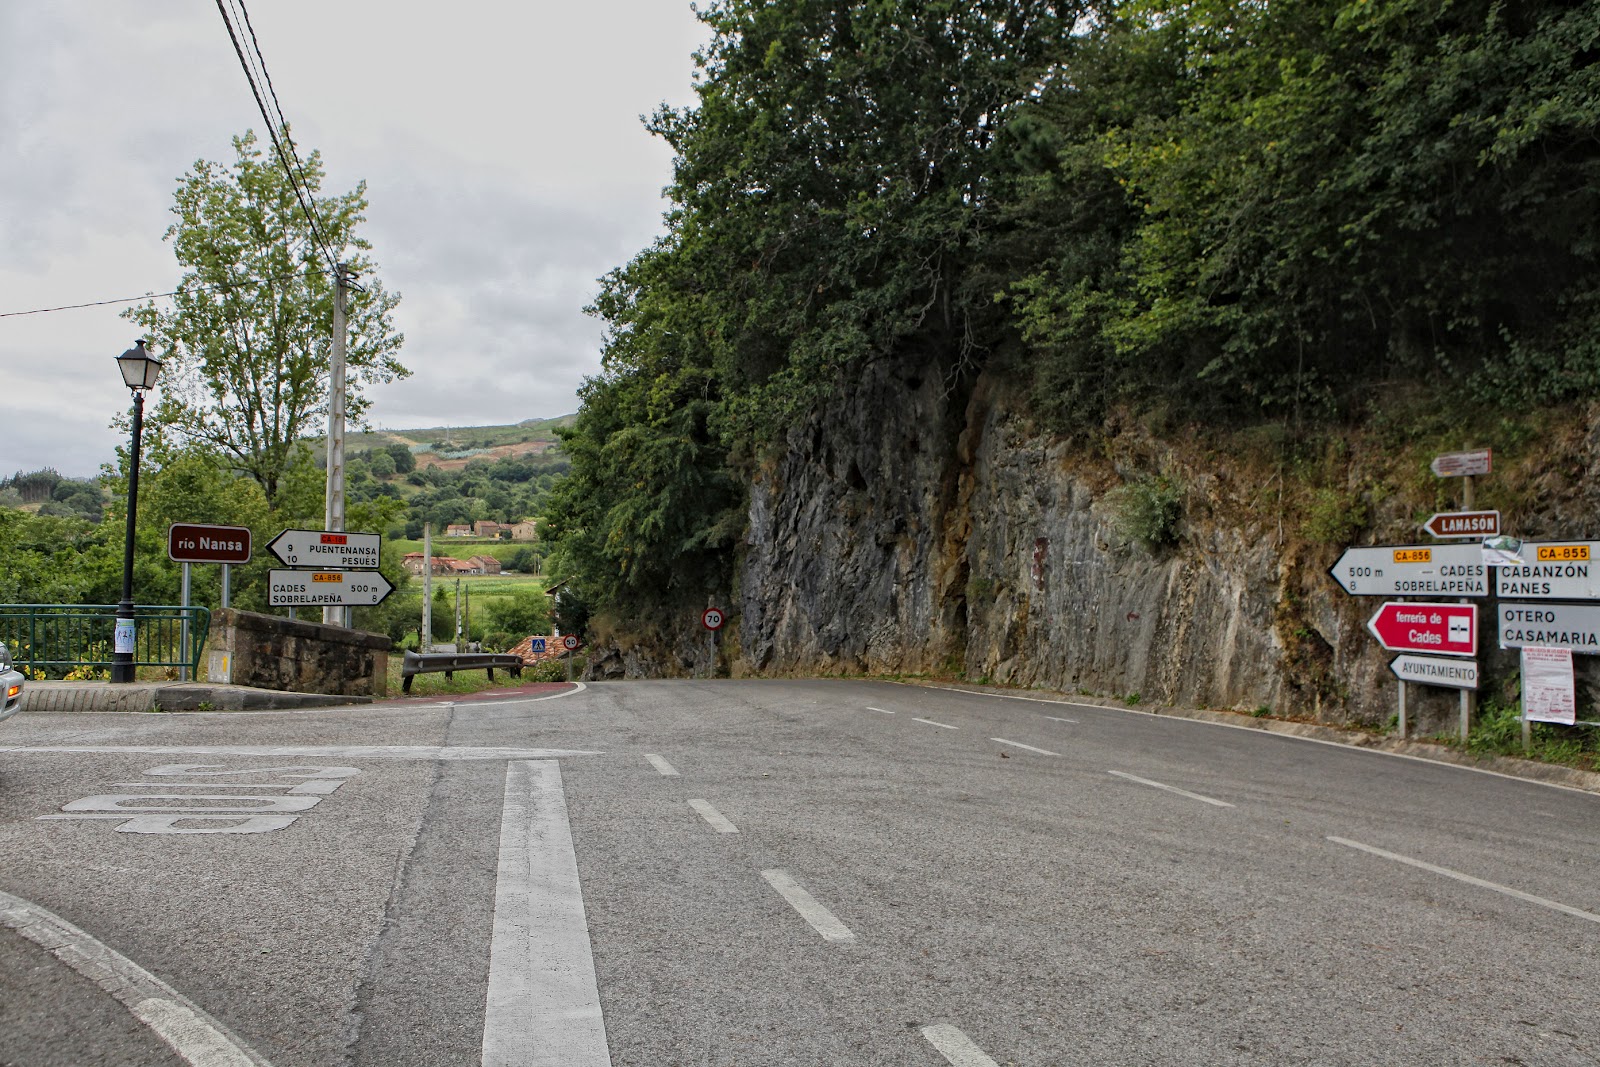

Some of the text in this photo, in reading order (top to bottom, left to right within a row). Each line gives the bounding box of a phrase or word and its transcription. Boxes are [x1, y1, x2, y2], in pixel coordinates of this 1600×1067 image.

[1442, 515, 1494, 531] LAMASÓN
[178, 537, 243, 551] río Nansa
[309, 546, 377, 555] PUENTENANSA
[1395, 551, 1430, 560] CA-856
[1540, 548, 1587, 558] CA-855
[1349, 568, 1383, 577] 500 m
[1441, 566, 1483, 576] CADES
[1502, 562, 1588, 577] CABANZÓN
[1350, 582, 1356, 590] 8
[1395, 578, 1484, 592] SOBRELAPEÑA
[1502, 582, 1550, 594] PANES
[273, 593, 342, 603] SOBRELAPEÑA
[1396, 612, 1441, 624] ferrería de
[1505, 611, 1555, 623] OTERO
[1409, 630, 1441, 644] Cades
[1505, 630, 1598, 645] CASAMARIA
[1402, 662, 1474, 680] AYUNTAMIENTO
